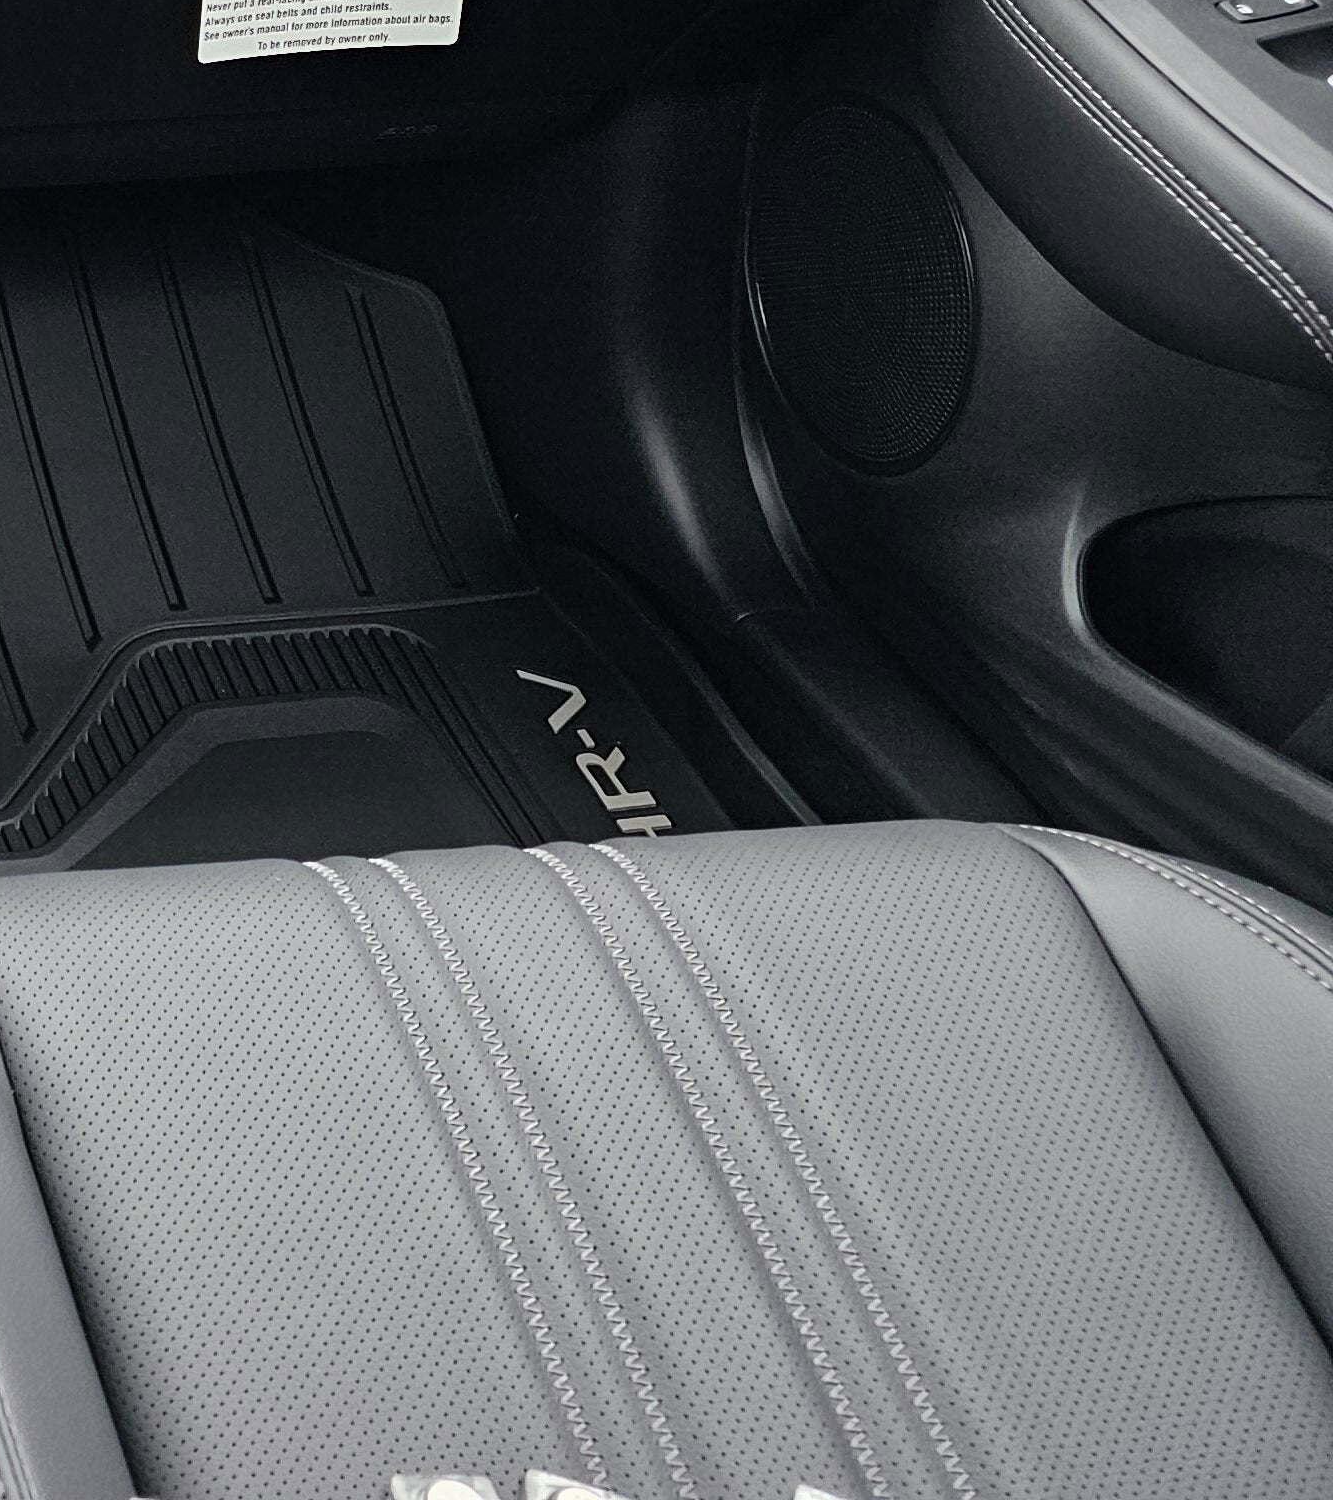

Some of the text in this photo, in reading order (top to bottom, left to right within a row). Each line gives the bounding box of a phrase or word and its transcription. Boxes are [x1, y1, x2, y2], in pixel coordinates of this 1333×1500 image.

[205, 3, 392, 27] Always use seat belts and child restraints.
[206, 3, 231, 13] Never
[234, 1, 248, 11] put
[204, 14, 453, 41] See owner's manual for more information about air bags.
[258, 32, 390, 50] To be removed by owner only.
